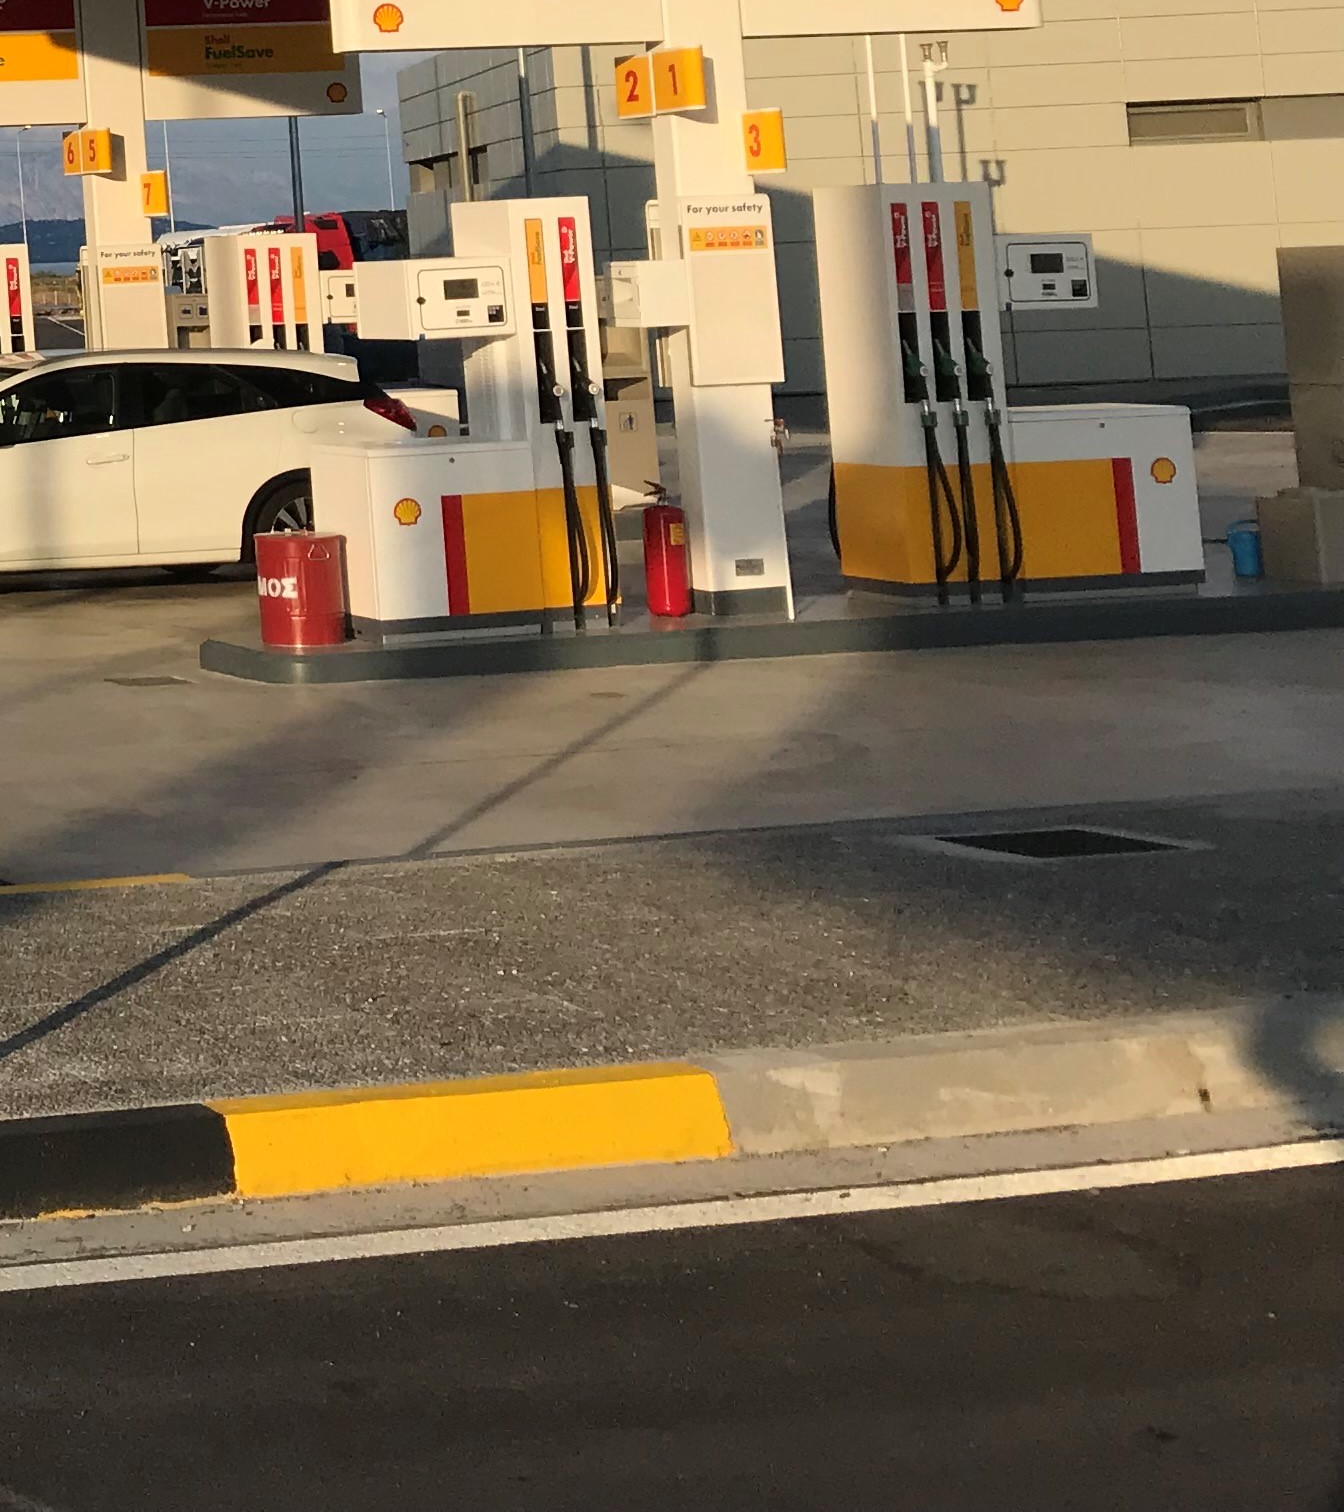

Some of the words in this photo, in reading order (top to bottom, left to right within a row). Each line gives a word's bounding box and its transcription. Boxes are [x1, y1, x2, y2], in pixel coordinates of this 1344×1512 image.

[205, 45, 274, 60] FuelSave
[624, 69, 640, 103] 2
[668, 63, 678, 96] 1
[89, 139, 96, 162] 5
[748, 123, 762, 157] 3
[67, 142, 74, 165] 6
[143, 182, 151, 206] 7
[687, 204, 703, 214] For
[705, 206, 729, 215] your
[731, 202, 763, 214] safety
[114, 251, 132, 259] your
[133, 249, 156, 258] safety
